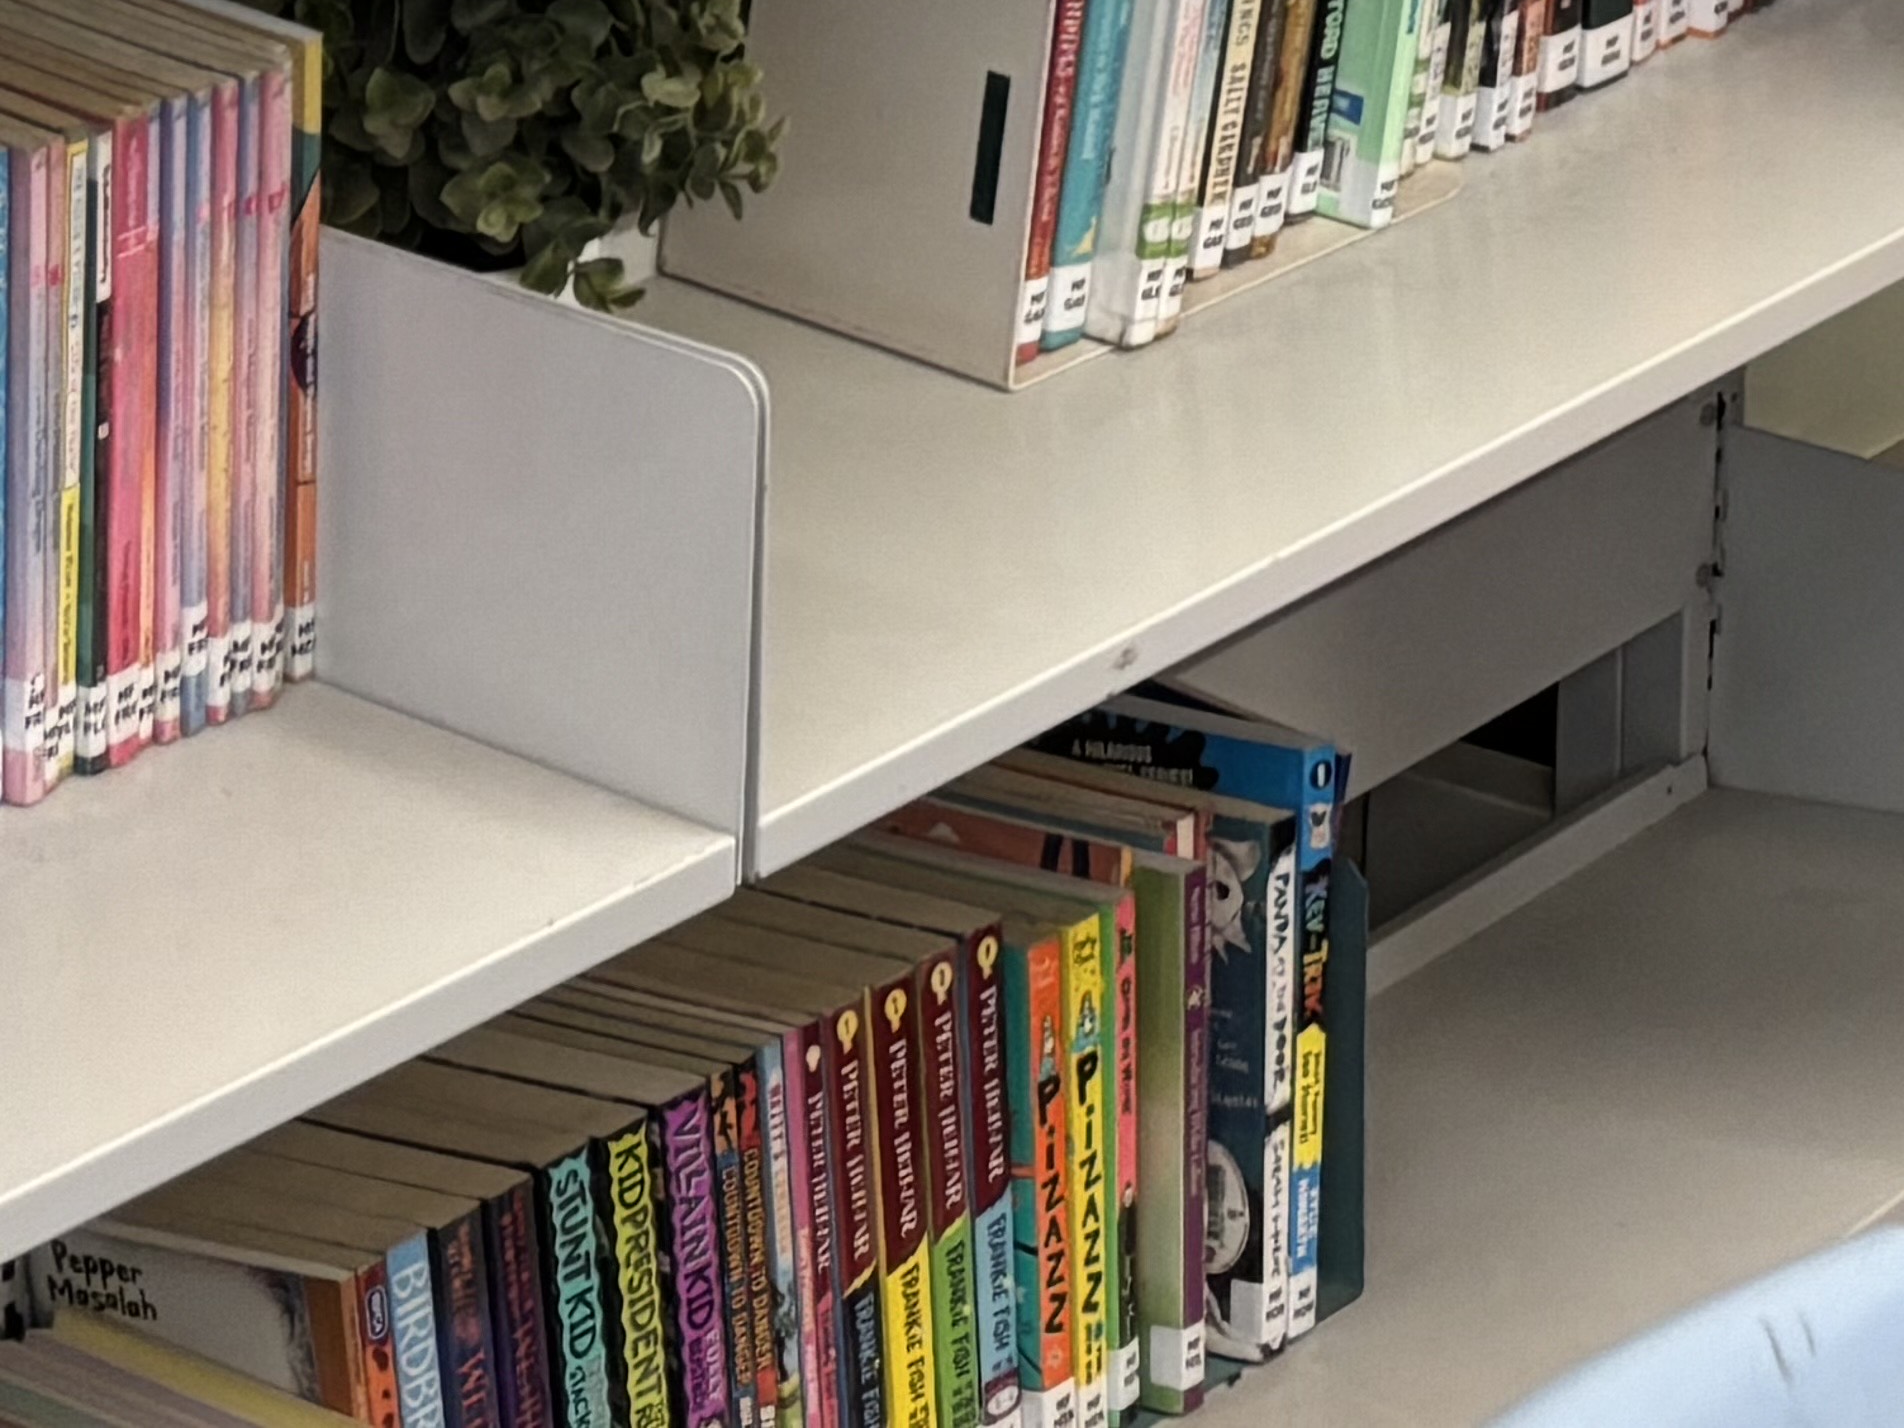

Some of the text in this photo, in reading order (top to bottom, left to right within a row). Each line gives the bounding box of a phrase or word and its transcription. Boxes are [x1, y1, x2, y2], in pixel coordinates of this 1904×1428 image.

[934, 1009, 956, 1114] PETER
[46, 1272, 158, 1324] Masalah
[50, 1240, 143, 1284] Pepper
[553, 1165, 597, 1361] STUNT KID
[614, 1145, 664, 1396] KID PRESIDENT
[906, 1350, 928, 1404] FISH
